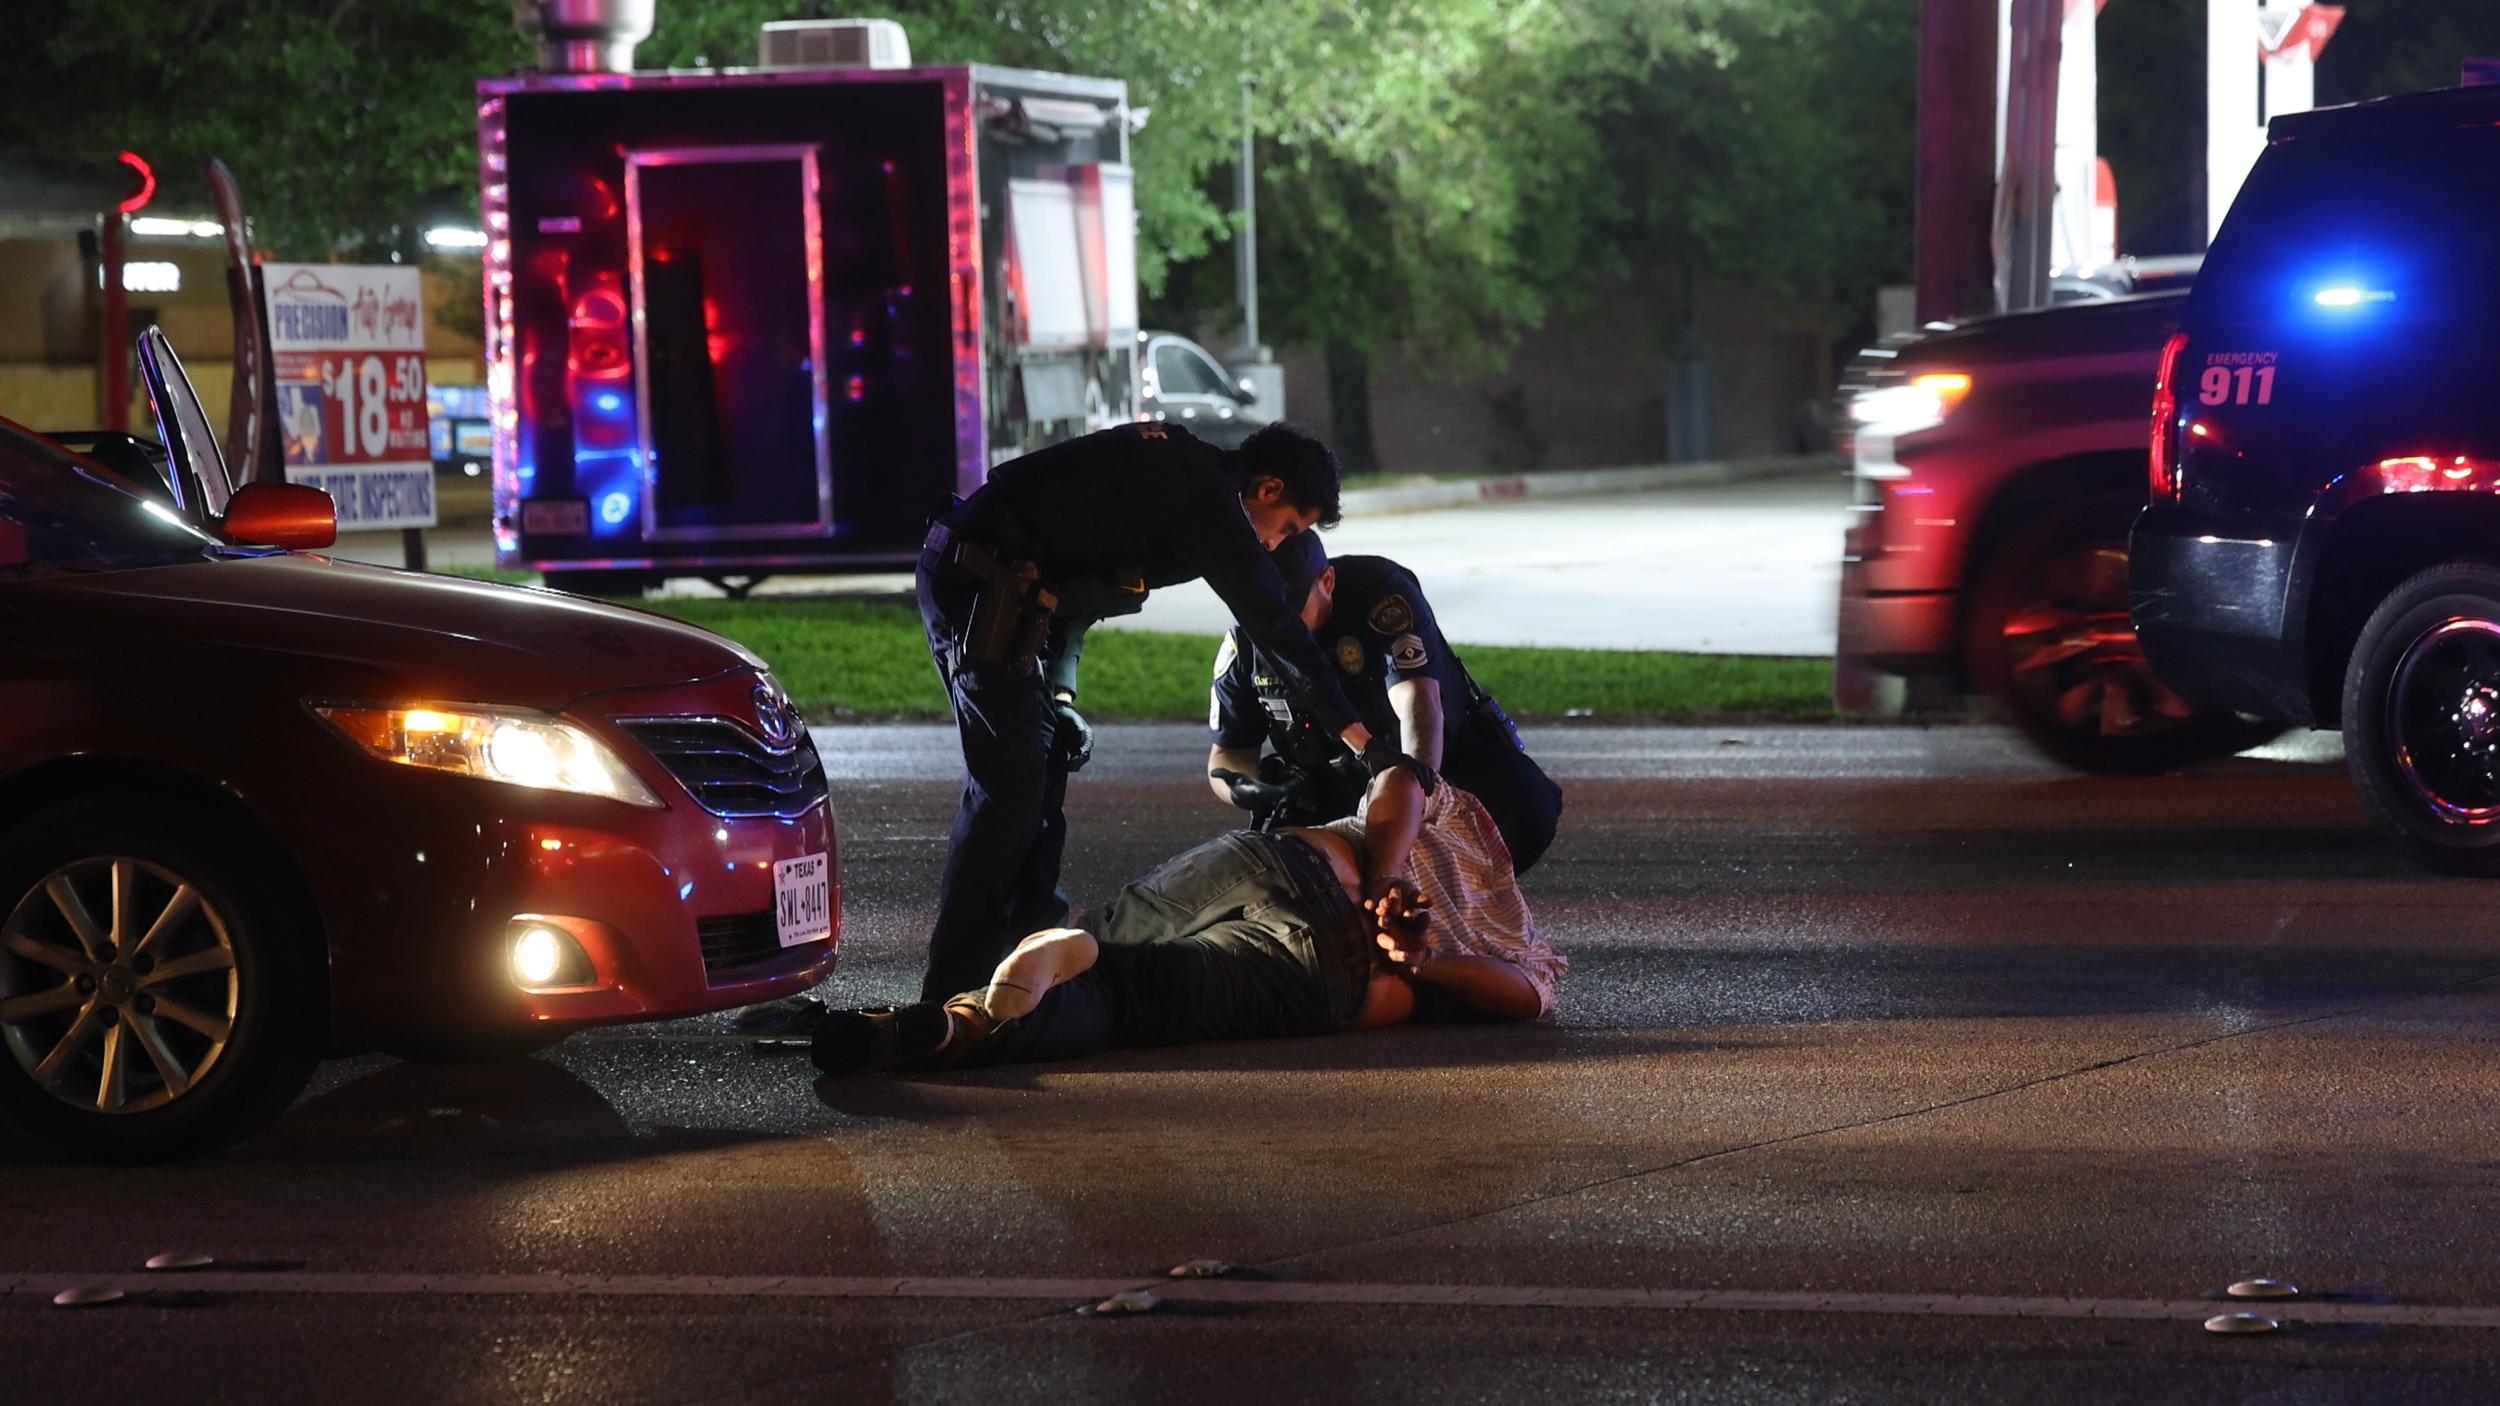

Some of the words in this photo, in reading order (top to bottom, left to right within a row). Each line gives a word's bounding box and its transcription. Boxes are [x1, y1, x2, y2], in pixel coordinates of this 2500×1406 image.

[275, 304, 348, 340] PRECISION
[2207, 352, 2278, 365] EMERGENCY
[2199, 366, 2276, 406] 911
[362, 470, 430, 519] INSPECTIONS
[794, 860, 815, 879] TEXAS
